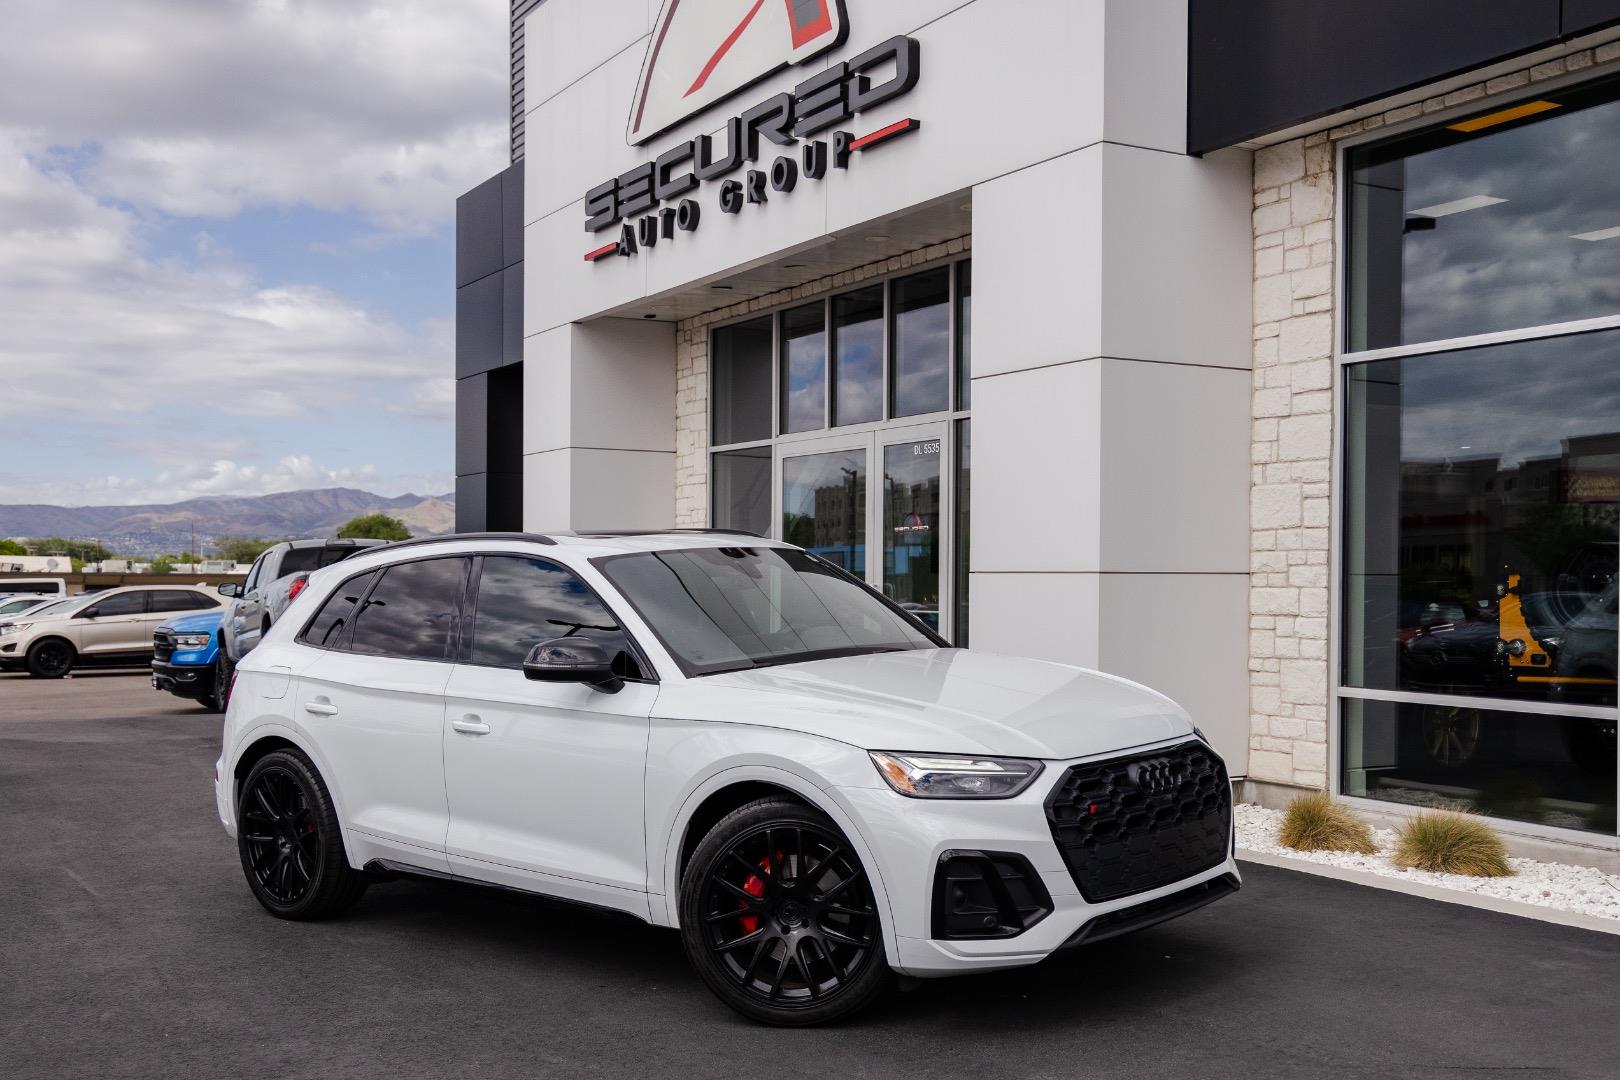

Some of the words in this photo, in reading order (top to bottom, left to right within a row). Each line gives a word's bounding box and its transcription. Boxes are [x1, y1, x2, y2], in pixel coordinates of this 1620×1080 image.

[584, 34, 920, 233] SECURED
[617, 198, 701, 257] AUTO
[719, 130, 855, 215] GROUP
[914, 444, 922, 455] DL
[923, 443, 939, 454] 5535
